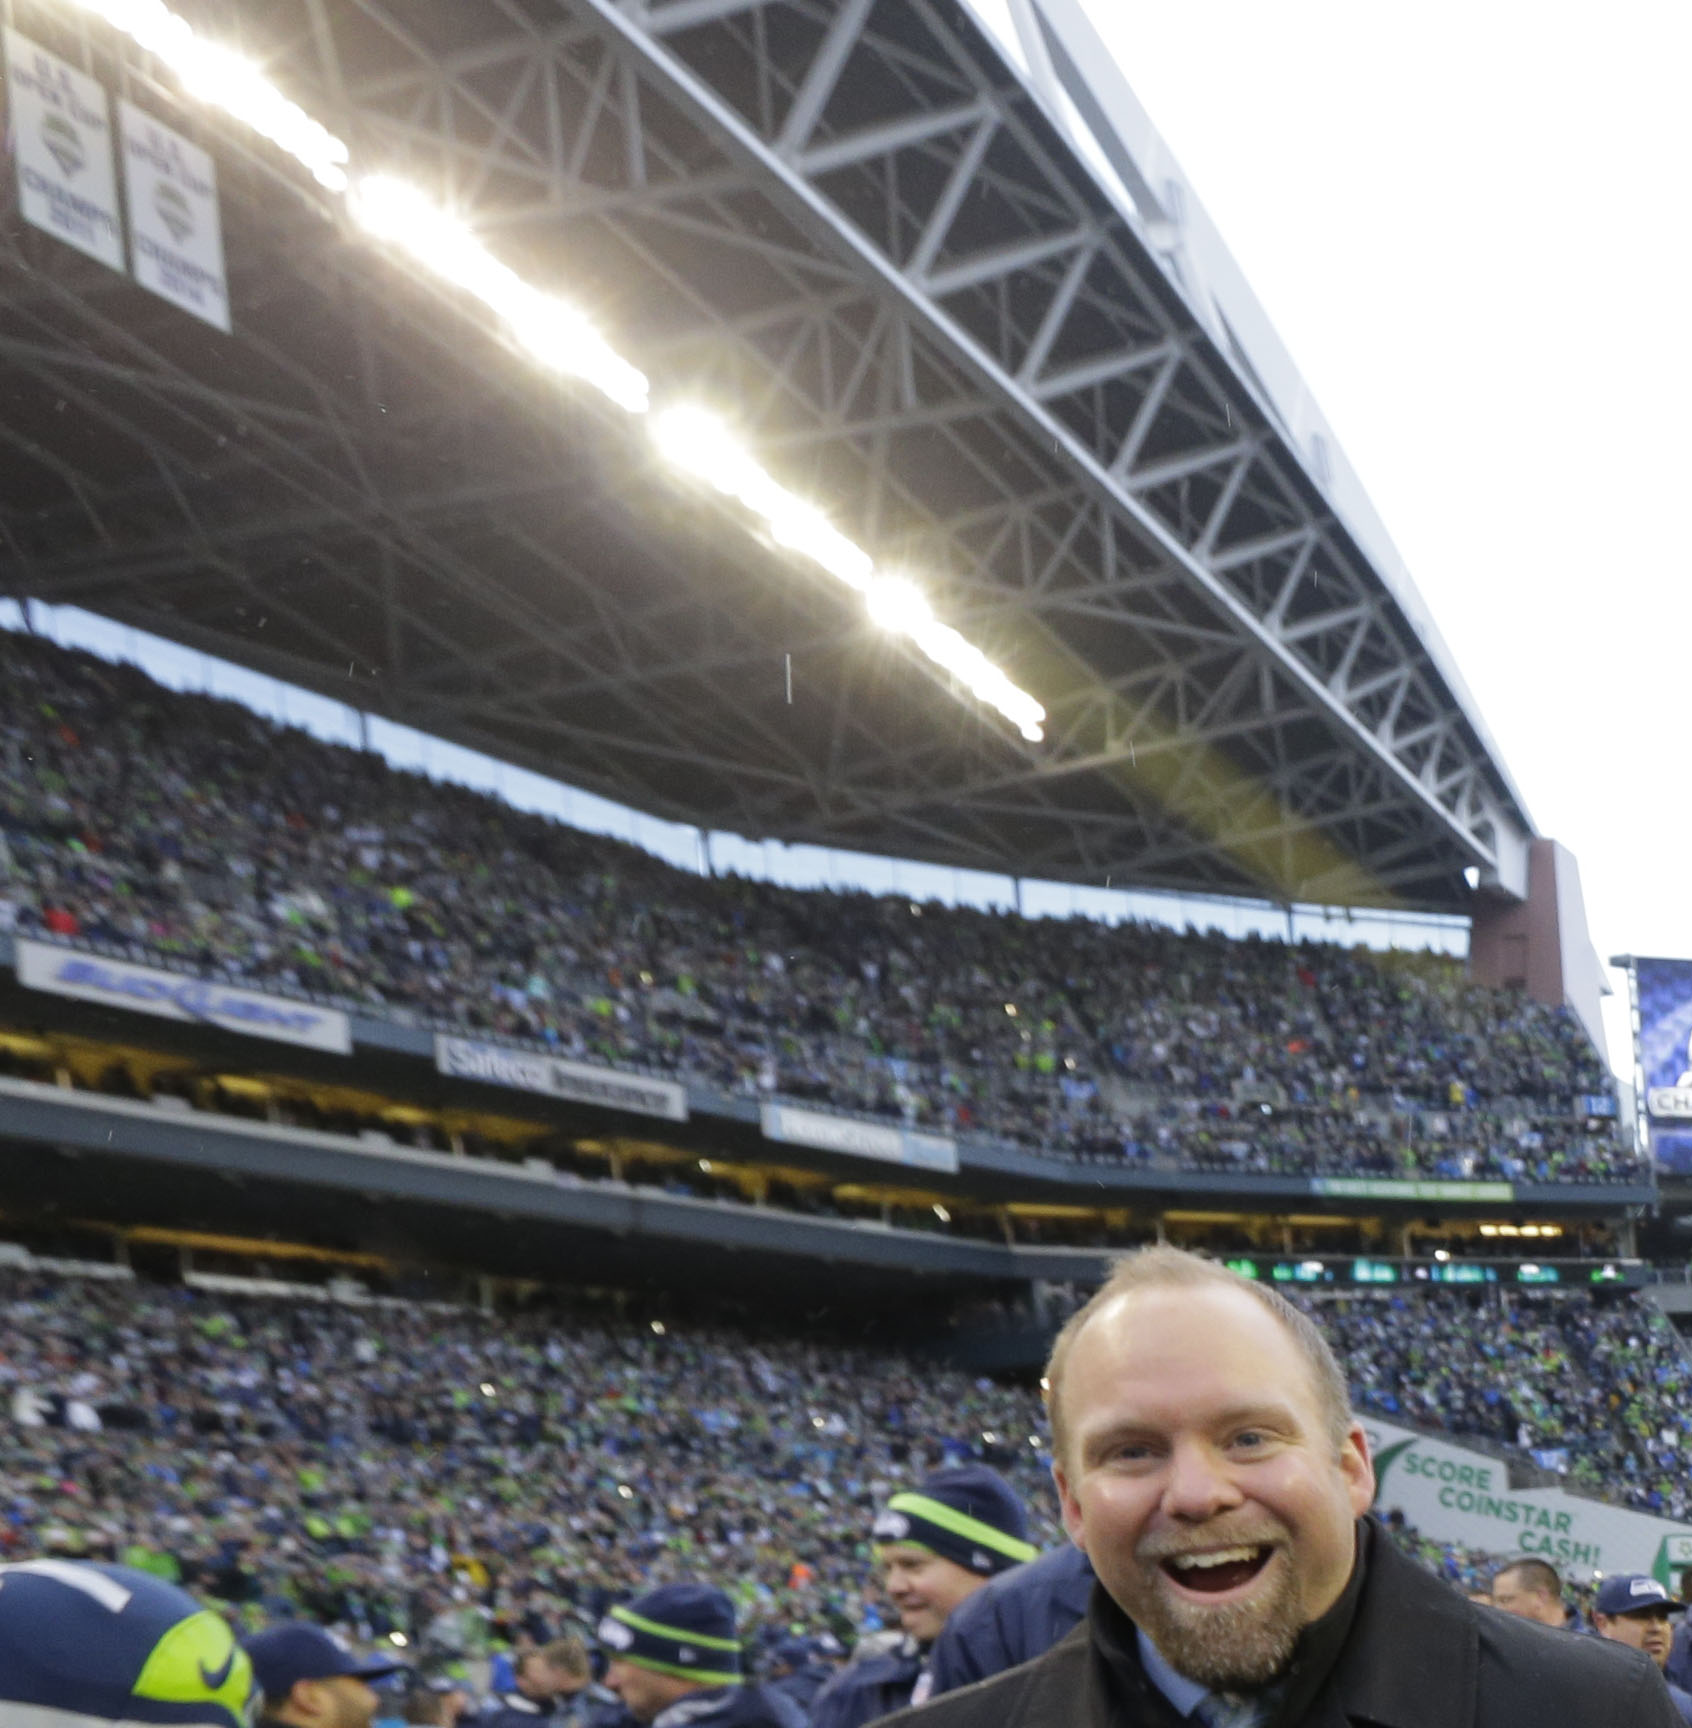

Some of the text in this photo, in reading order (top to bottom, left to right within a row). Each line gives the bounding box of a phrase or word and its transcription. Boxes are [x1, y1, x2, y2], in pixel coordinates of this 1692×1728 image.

[1404, 1453, 1492, 1491] SCORE
[1439, 1487, 1571, 1535] COINSTAR
[1519, 1530, 1600, 1567] CASH!
